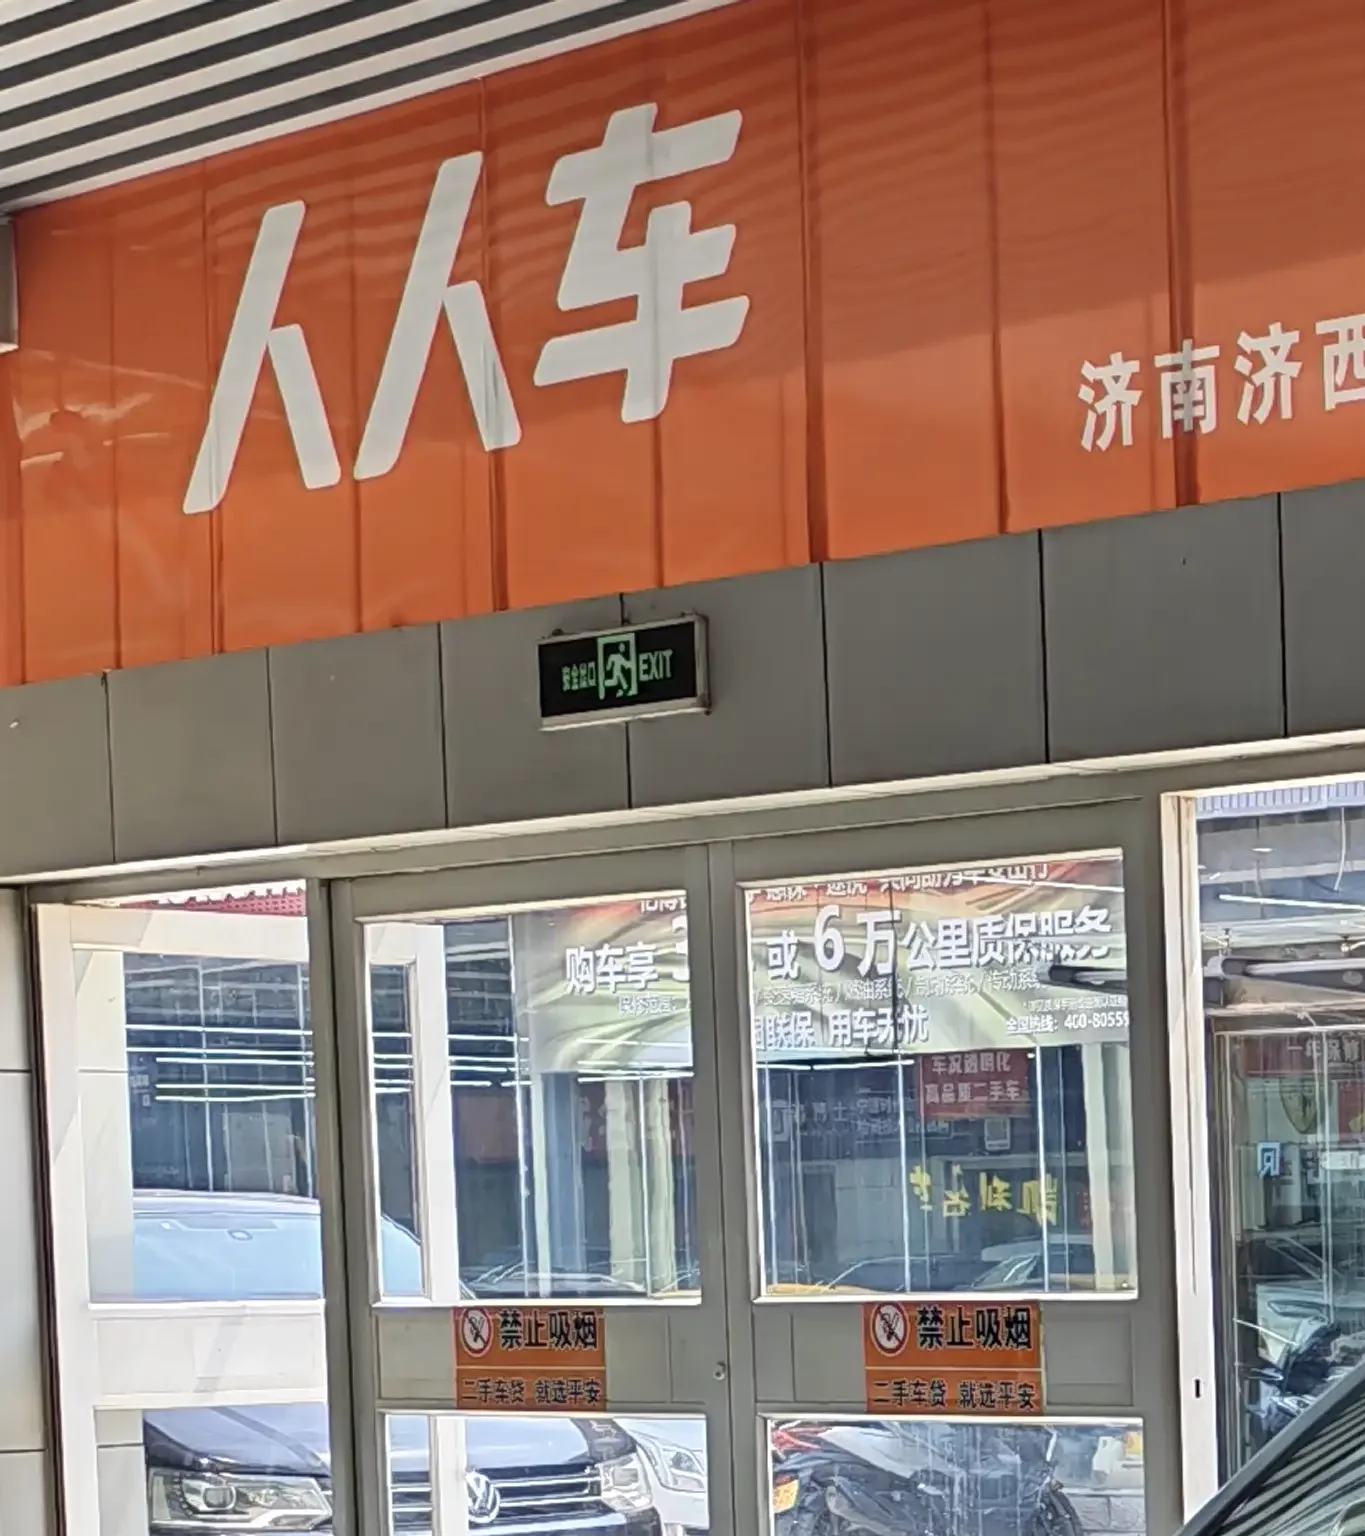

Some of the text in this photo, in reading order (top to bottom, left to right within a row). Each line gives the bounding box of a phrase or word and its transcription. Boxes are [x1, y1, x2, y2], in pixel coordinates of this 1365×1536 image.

[181, 102, 751, 515] 人人车
[638, 648, 674, 682] EXIT
[565, 940, 660, 995] 购车享
[499, 1308, 598, 1351] 禁止吸烟
[917, 1304, 1033, 1351] 禁止吸烟
[461, 1377, 526, 1405] 二手车贷
[872, 1379, 948, 1408] 二手车贷
